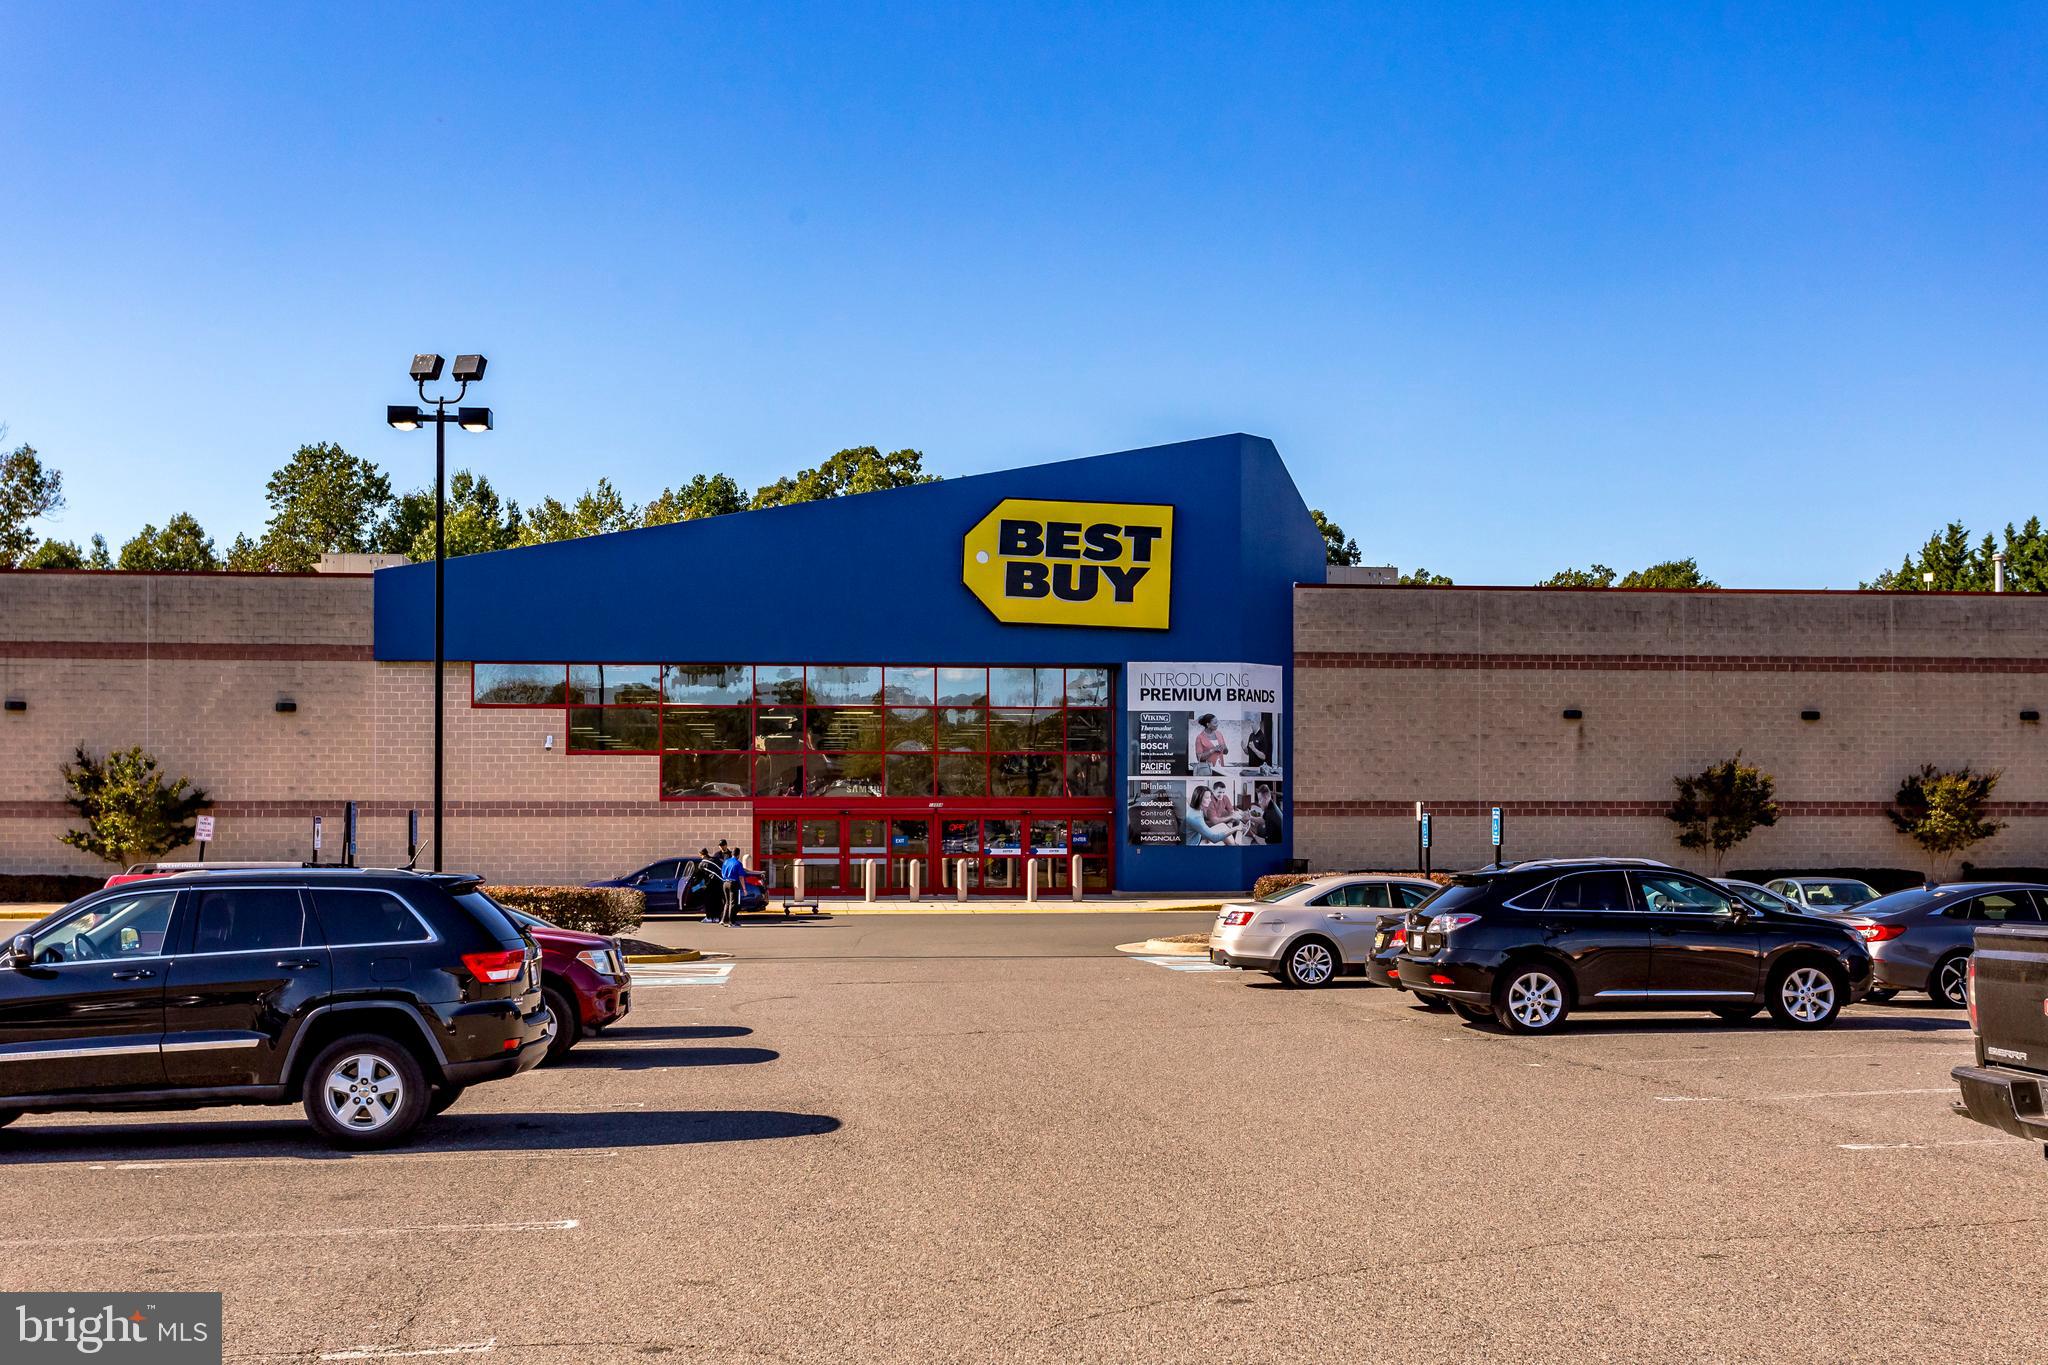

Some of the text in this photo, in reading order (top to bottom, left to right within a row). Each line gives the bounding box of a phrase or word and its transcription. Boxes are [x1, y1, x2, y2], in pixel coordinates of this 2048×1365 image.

[998, 519, 1163, 562] BEST
[1005, 561, 1151, 603] BUY
[1140, 672, 1250, 687] INTRODUCING
[1140, 688, 1275, 704] PREMIUM BRANDS
[1140, 742, 1169, 750] BOSCH
[1140, 762, 1172, 771] PACIFIC
[1140, 800, 1174, 809] audioquest
[1987, 1046, 2027, 1061] SIERRA
